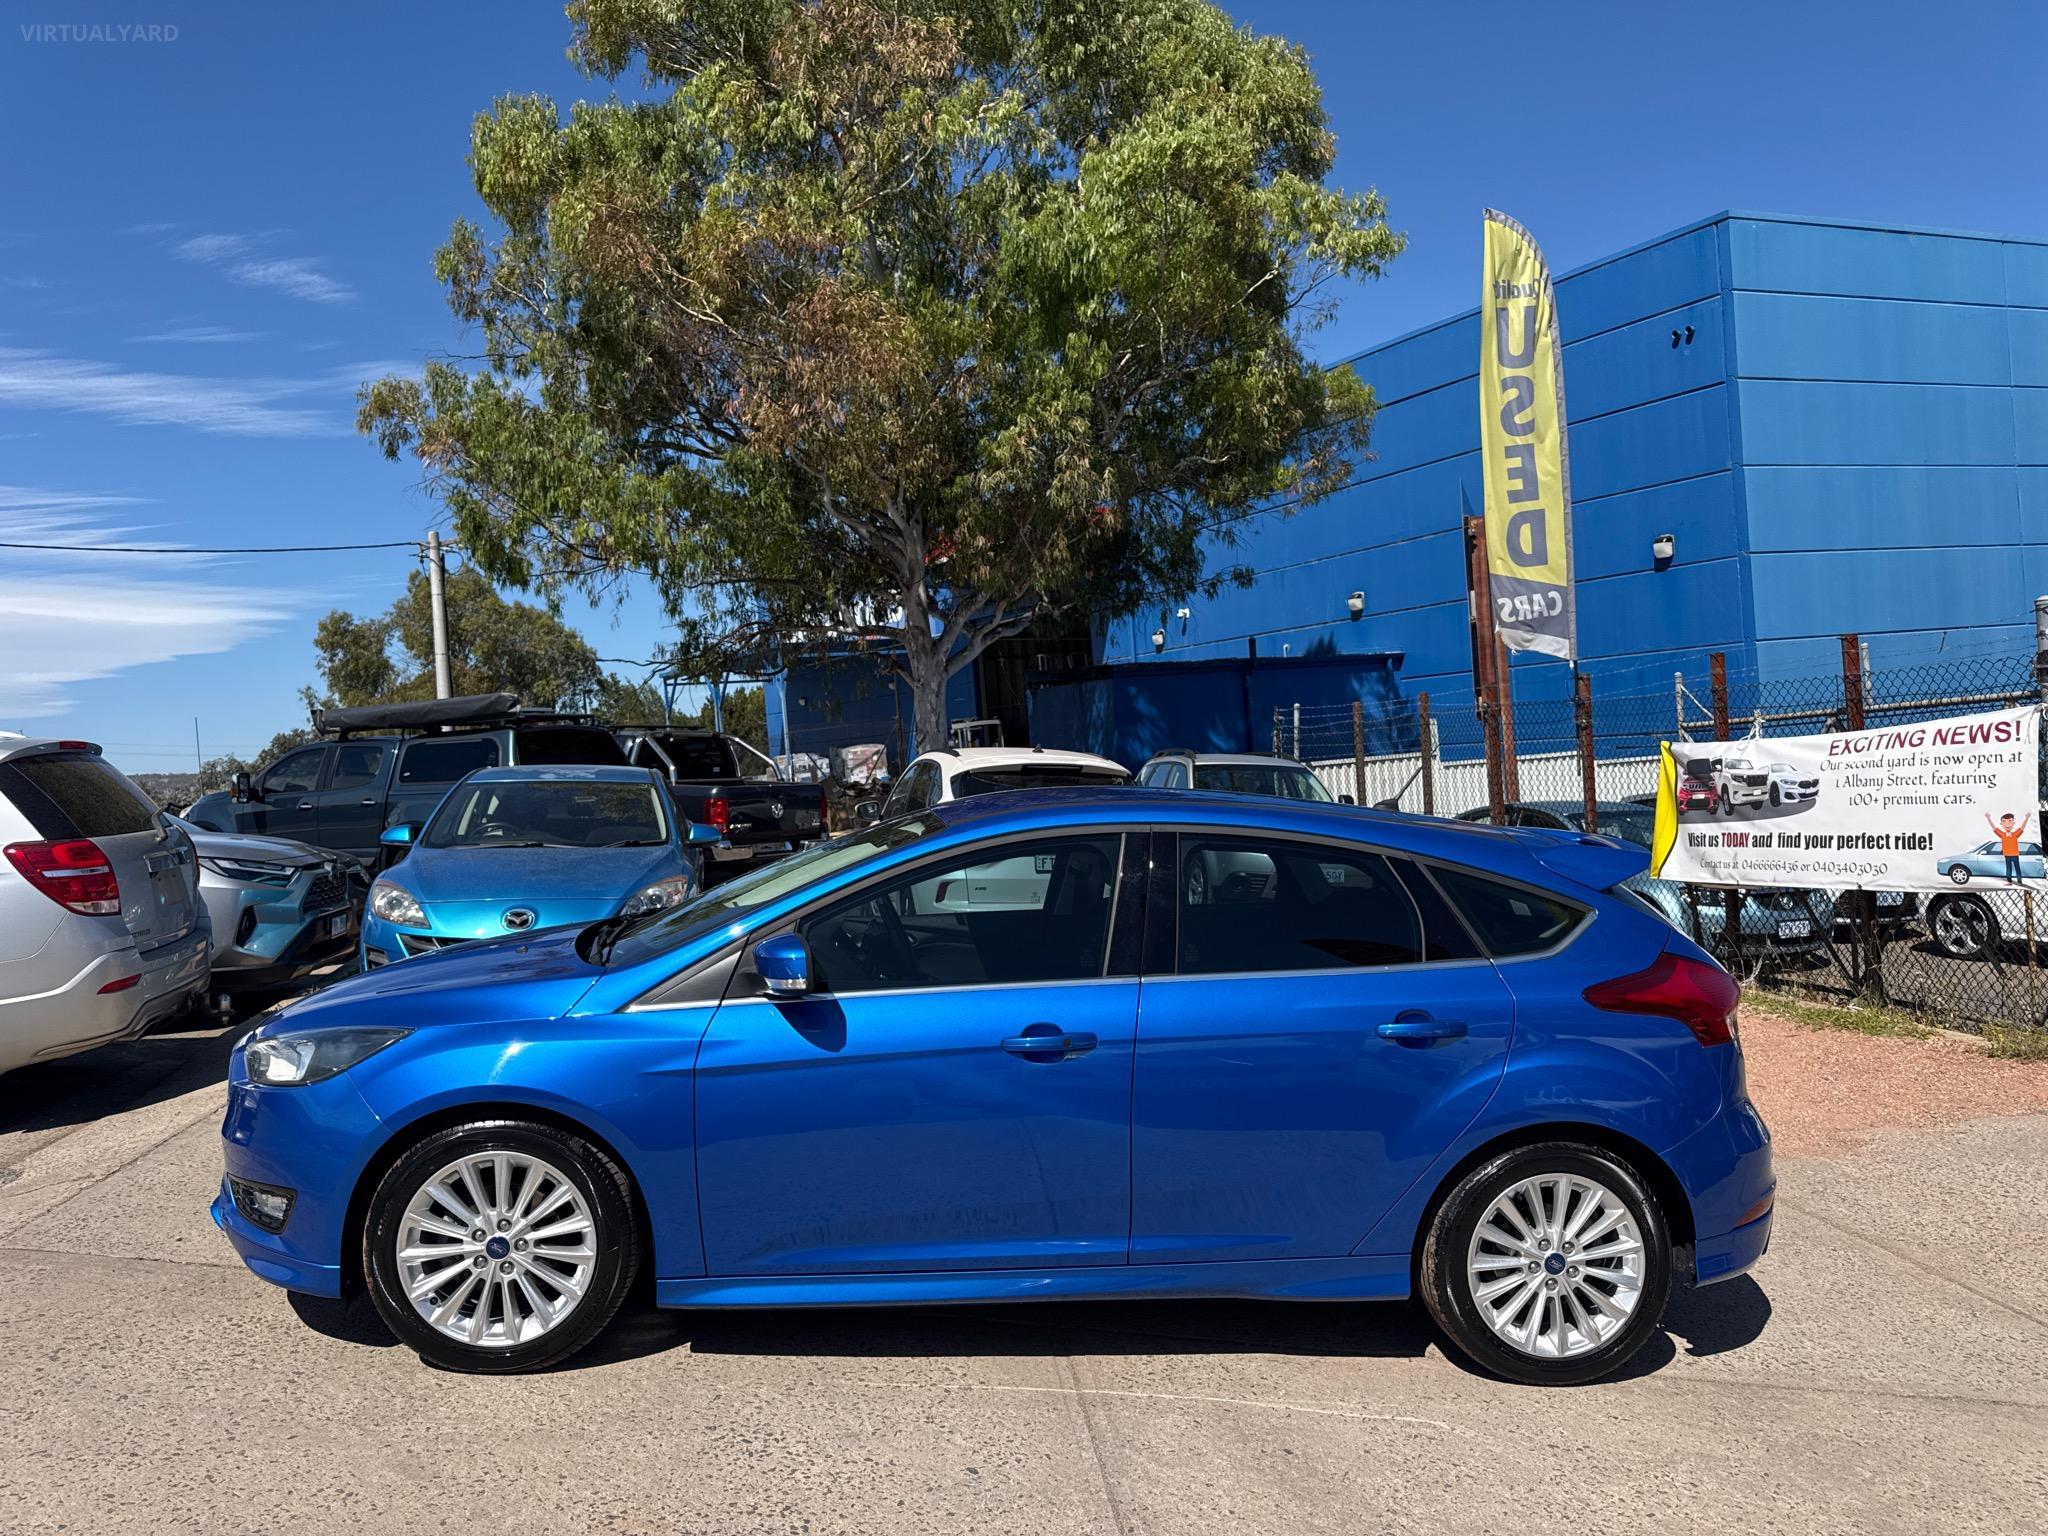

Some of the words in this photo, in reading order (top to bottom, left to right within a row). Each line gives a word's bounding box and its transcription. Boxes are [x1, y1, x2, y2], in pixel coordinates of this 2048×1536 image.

[1829, 729, 1926, 756] EXCITING
[1933, 721, 2021, 746] NEWS!
[1820, 759, 1842, 771] Our
[1845, 755, 1883, 770] second
[1888, 753, 1915, 772] yard
[1920, 752, 1929, 765] is
[1934, 755, 1963, 765] now
[1968, 753, 2003, 769] open
[2009, 752, 2023, 762] at
[1843, 774, 1883, 791] Albany
[1887, 774, 1927, 786] Street,
[1932, 770, 1997, 788] featuring
[1850, 794, 1879, 806] 100+
[1883, 791, 1938, 809] premium
[1943, 794, 1976, 805] cars.
[1688, 833, 1706, 847] Visit
[1708, 836, 1719, 847] us
[1721, 833, 1750, 847] TODAY
[1752, 833, 1772, 848] and
[1778, 832, 1800, 848] find
[1804, 836, 1833, 850] your
[1837, 833, 1890, 850] perfect
[1895, 833, 1933, 850] ride!
[1701, 859, 1722, 869] Contact
[1801, 863, 1810, 871] or
[1813, 861, 1887, 876] 0403403030
